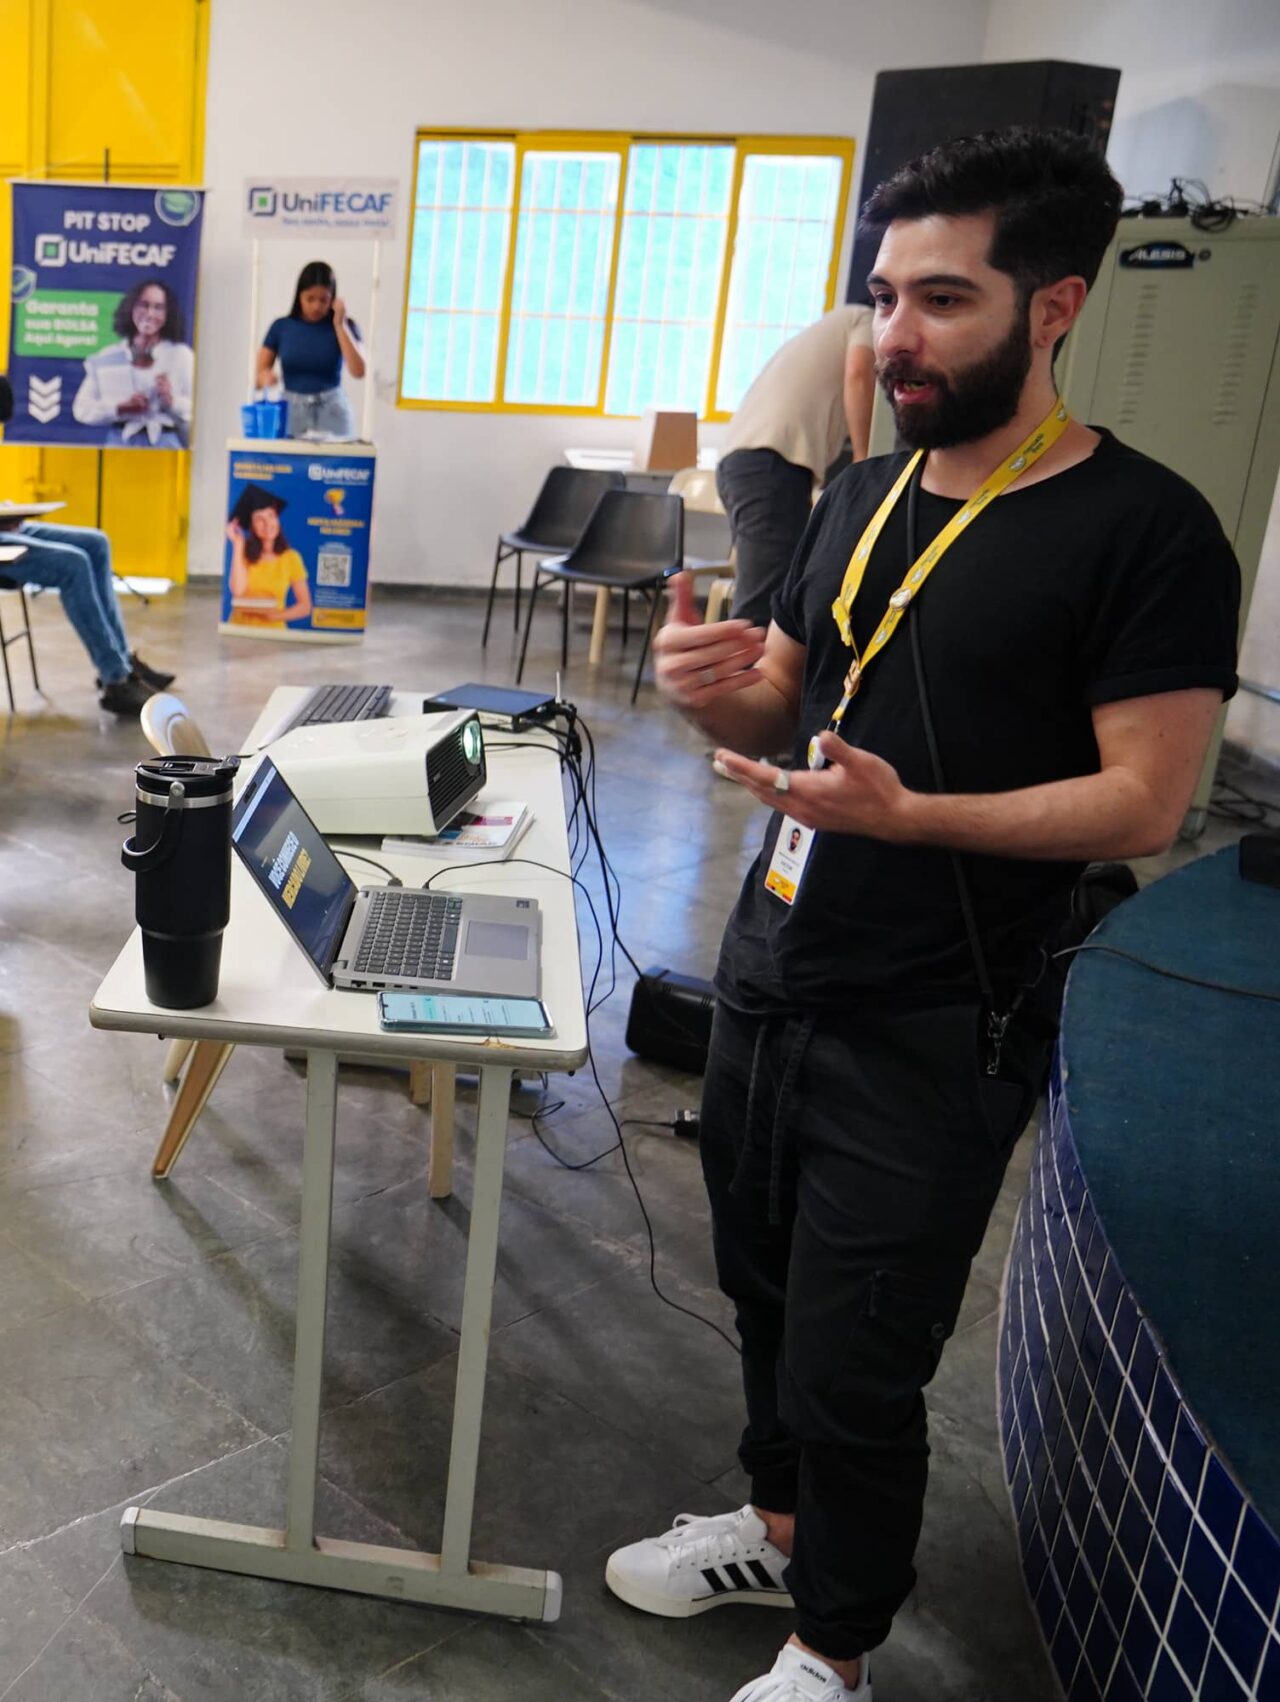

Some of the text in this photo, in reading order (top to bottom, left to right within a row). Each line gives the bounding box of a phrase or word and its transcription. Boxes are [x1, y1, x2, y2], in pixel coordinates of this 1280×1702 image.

[283, 193, 392, 213] UniFECAF
[64, 210, 150, 232] PIT STOP
[69, 239, 177, 267] UniFECAF
[800, 1663, 827, 1683] adidas
